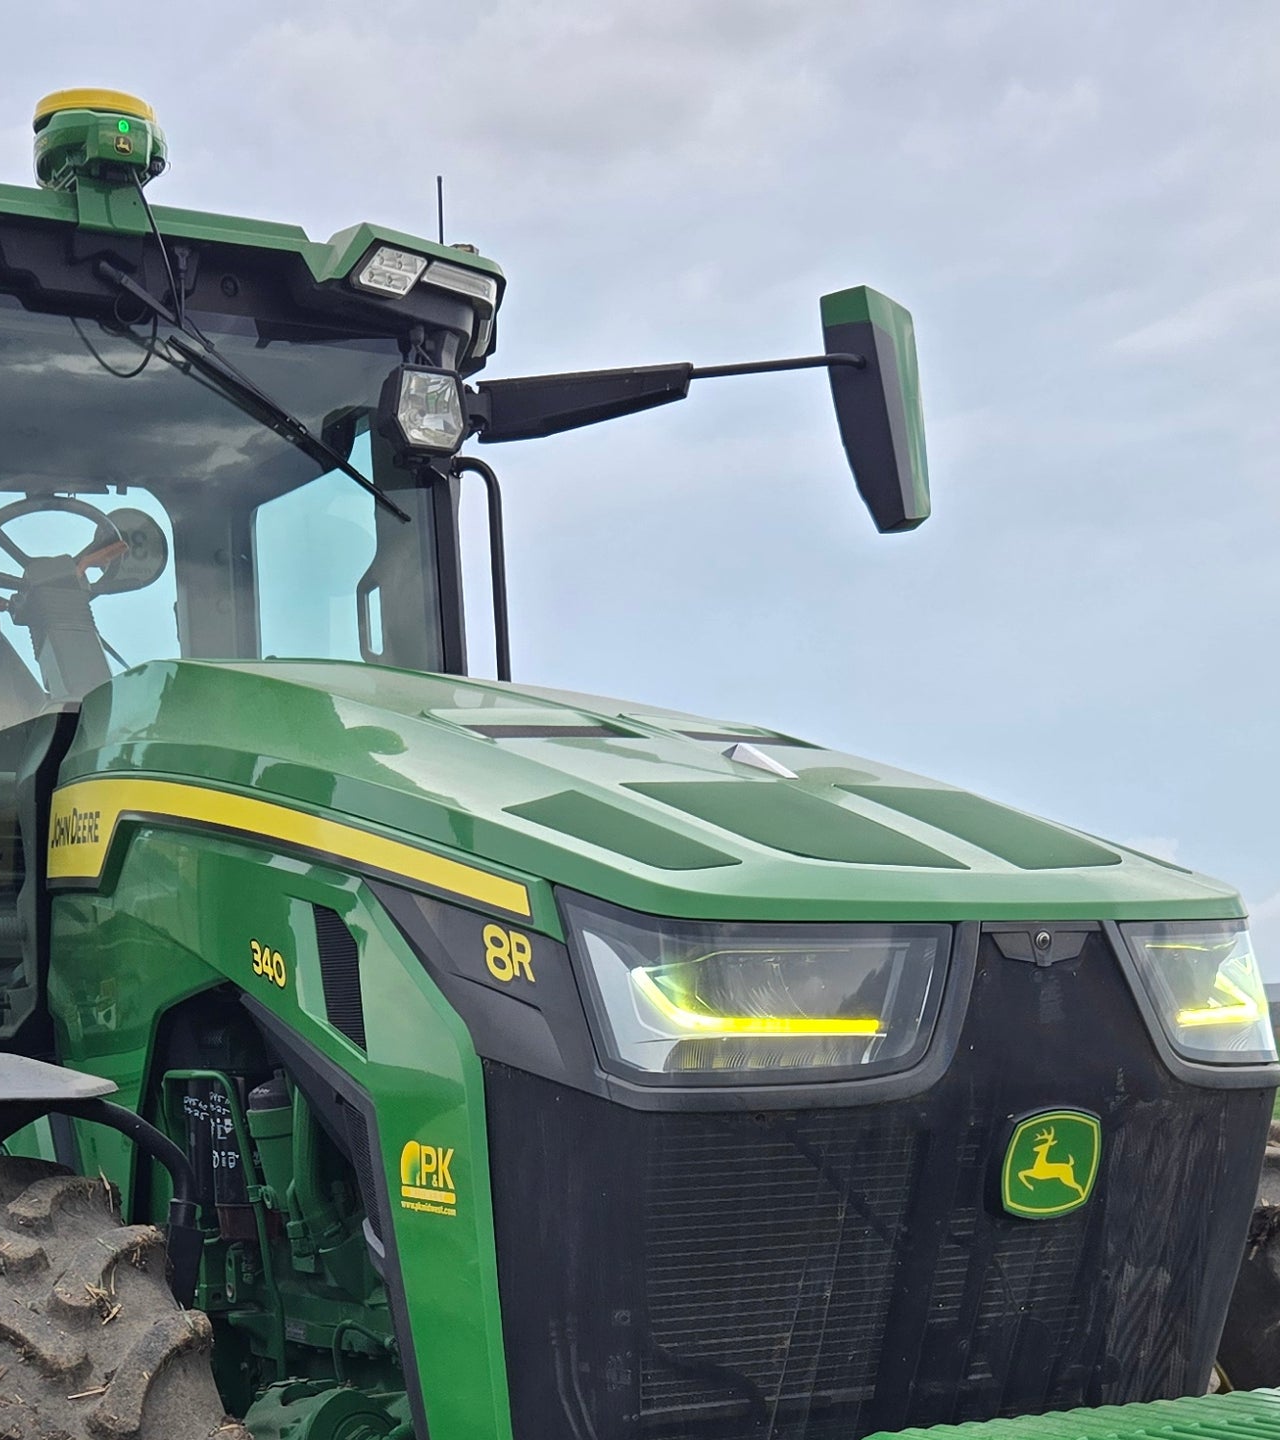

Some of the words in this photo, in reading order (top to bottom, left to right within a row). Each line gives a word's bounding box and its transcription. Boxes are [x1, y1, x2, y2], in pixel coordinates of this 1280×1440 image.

[51, 812, 71, 849] JOHN
[70, 808, 101, 845] DEERE
[250, 939, 287, 988] 340
[482, 923, 536, 983] 8R
[420, 1145, 455, 1190] P&K
